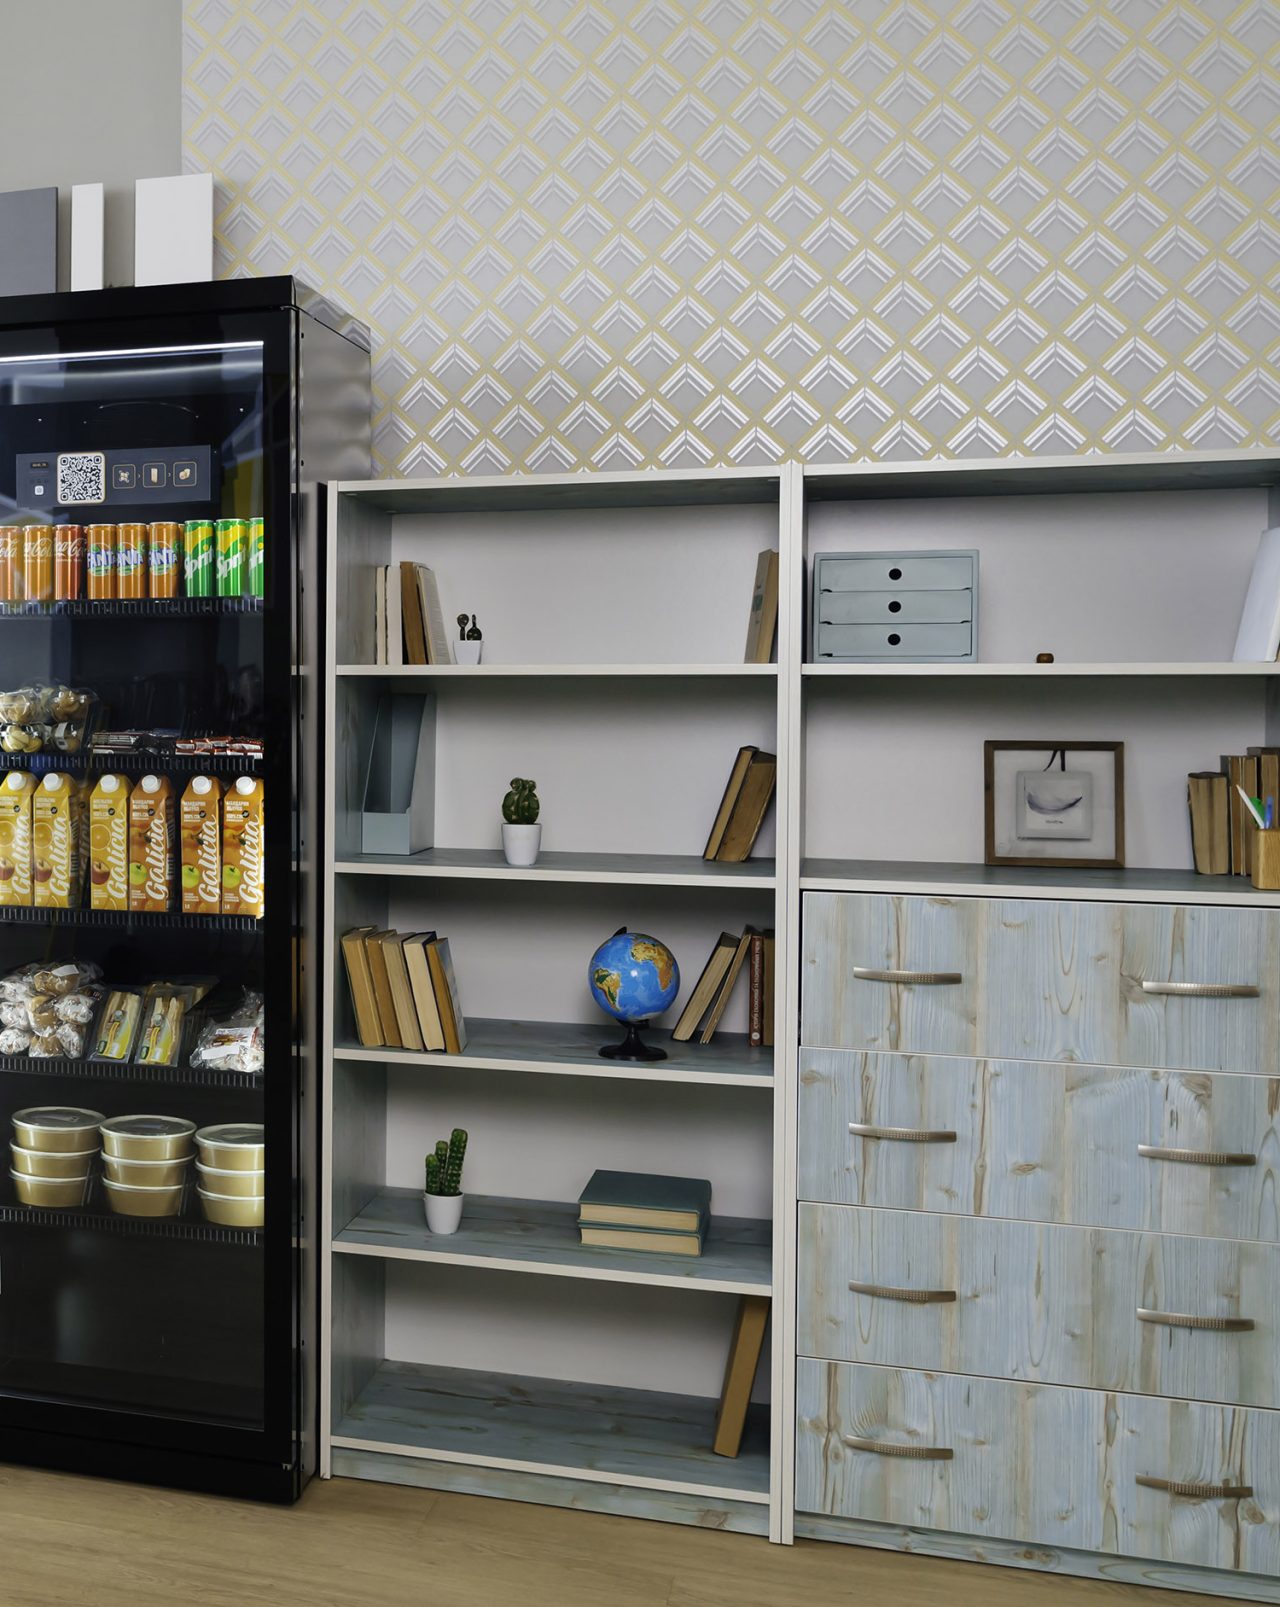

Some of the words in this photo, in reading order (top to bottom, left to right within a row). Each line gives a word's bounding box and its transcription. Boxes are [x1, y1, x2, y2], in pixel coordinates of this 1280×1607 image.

[184, 544, 215, 580] Sprit
[216, 544, 247, 579] Sprit
[12, 809, 31, 895] Galicia
[49, 810, 70, 896] Galicia
[107, 811, 127, 899] Galicia
[145, 811, 168, 900] Galicia
[198, 814, 220, 903] Galicia
[239, 814, 263, 904] Galicia
